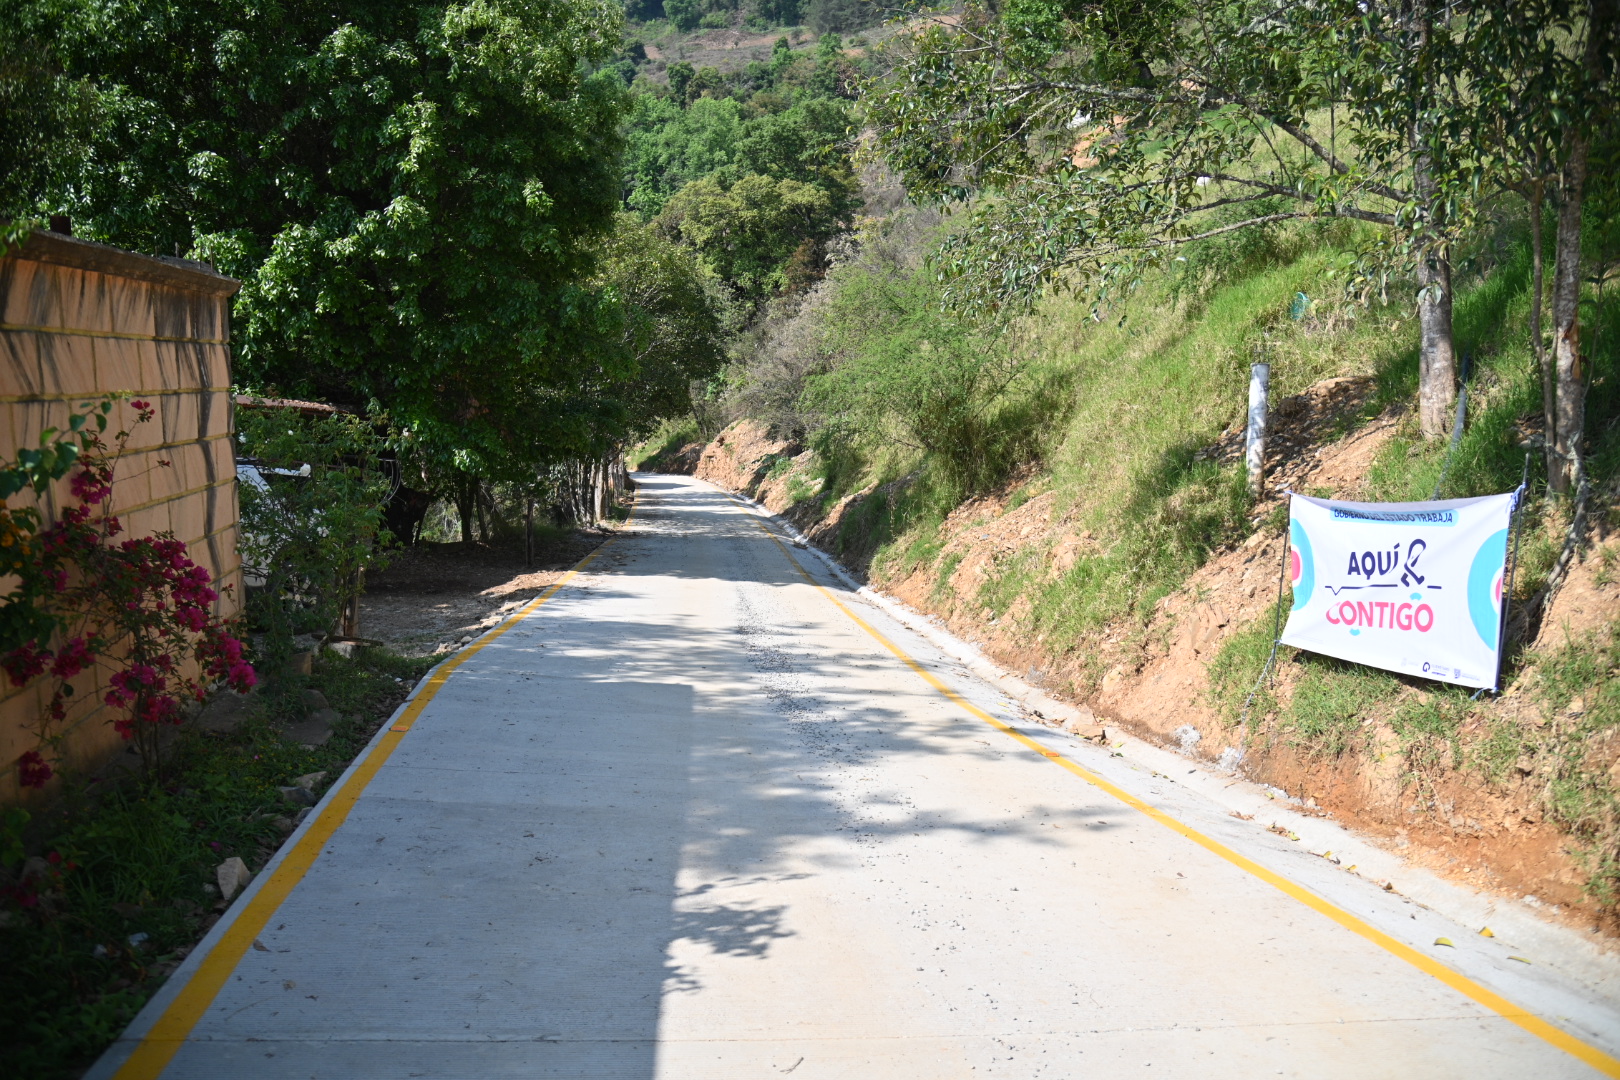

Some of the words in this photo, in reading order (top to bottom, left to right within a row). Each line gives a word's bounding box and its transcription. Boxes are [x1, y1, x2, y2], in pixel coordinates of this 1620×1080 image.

[1416, 512, 1453, 523] TRABAJA
[1347, 542, 1400, 580] AQUÍ
[1325, 600, 1434, 632] CONTIGO
